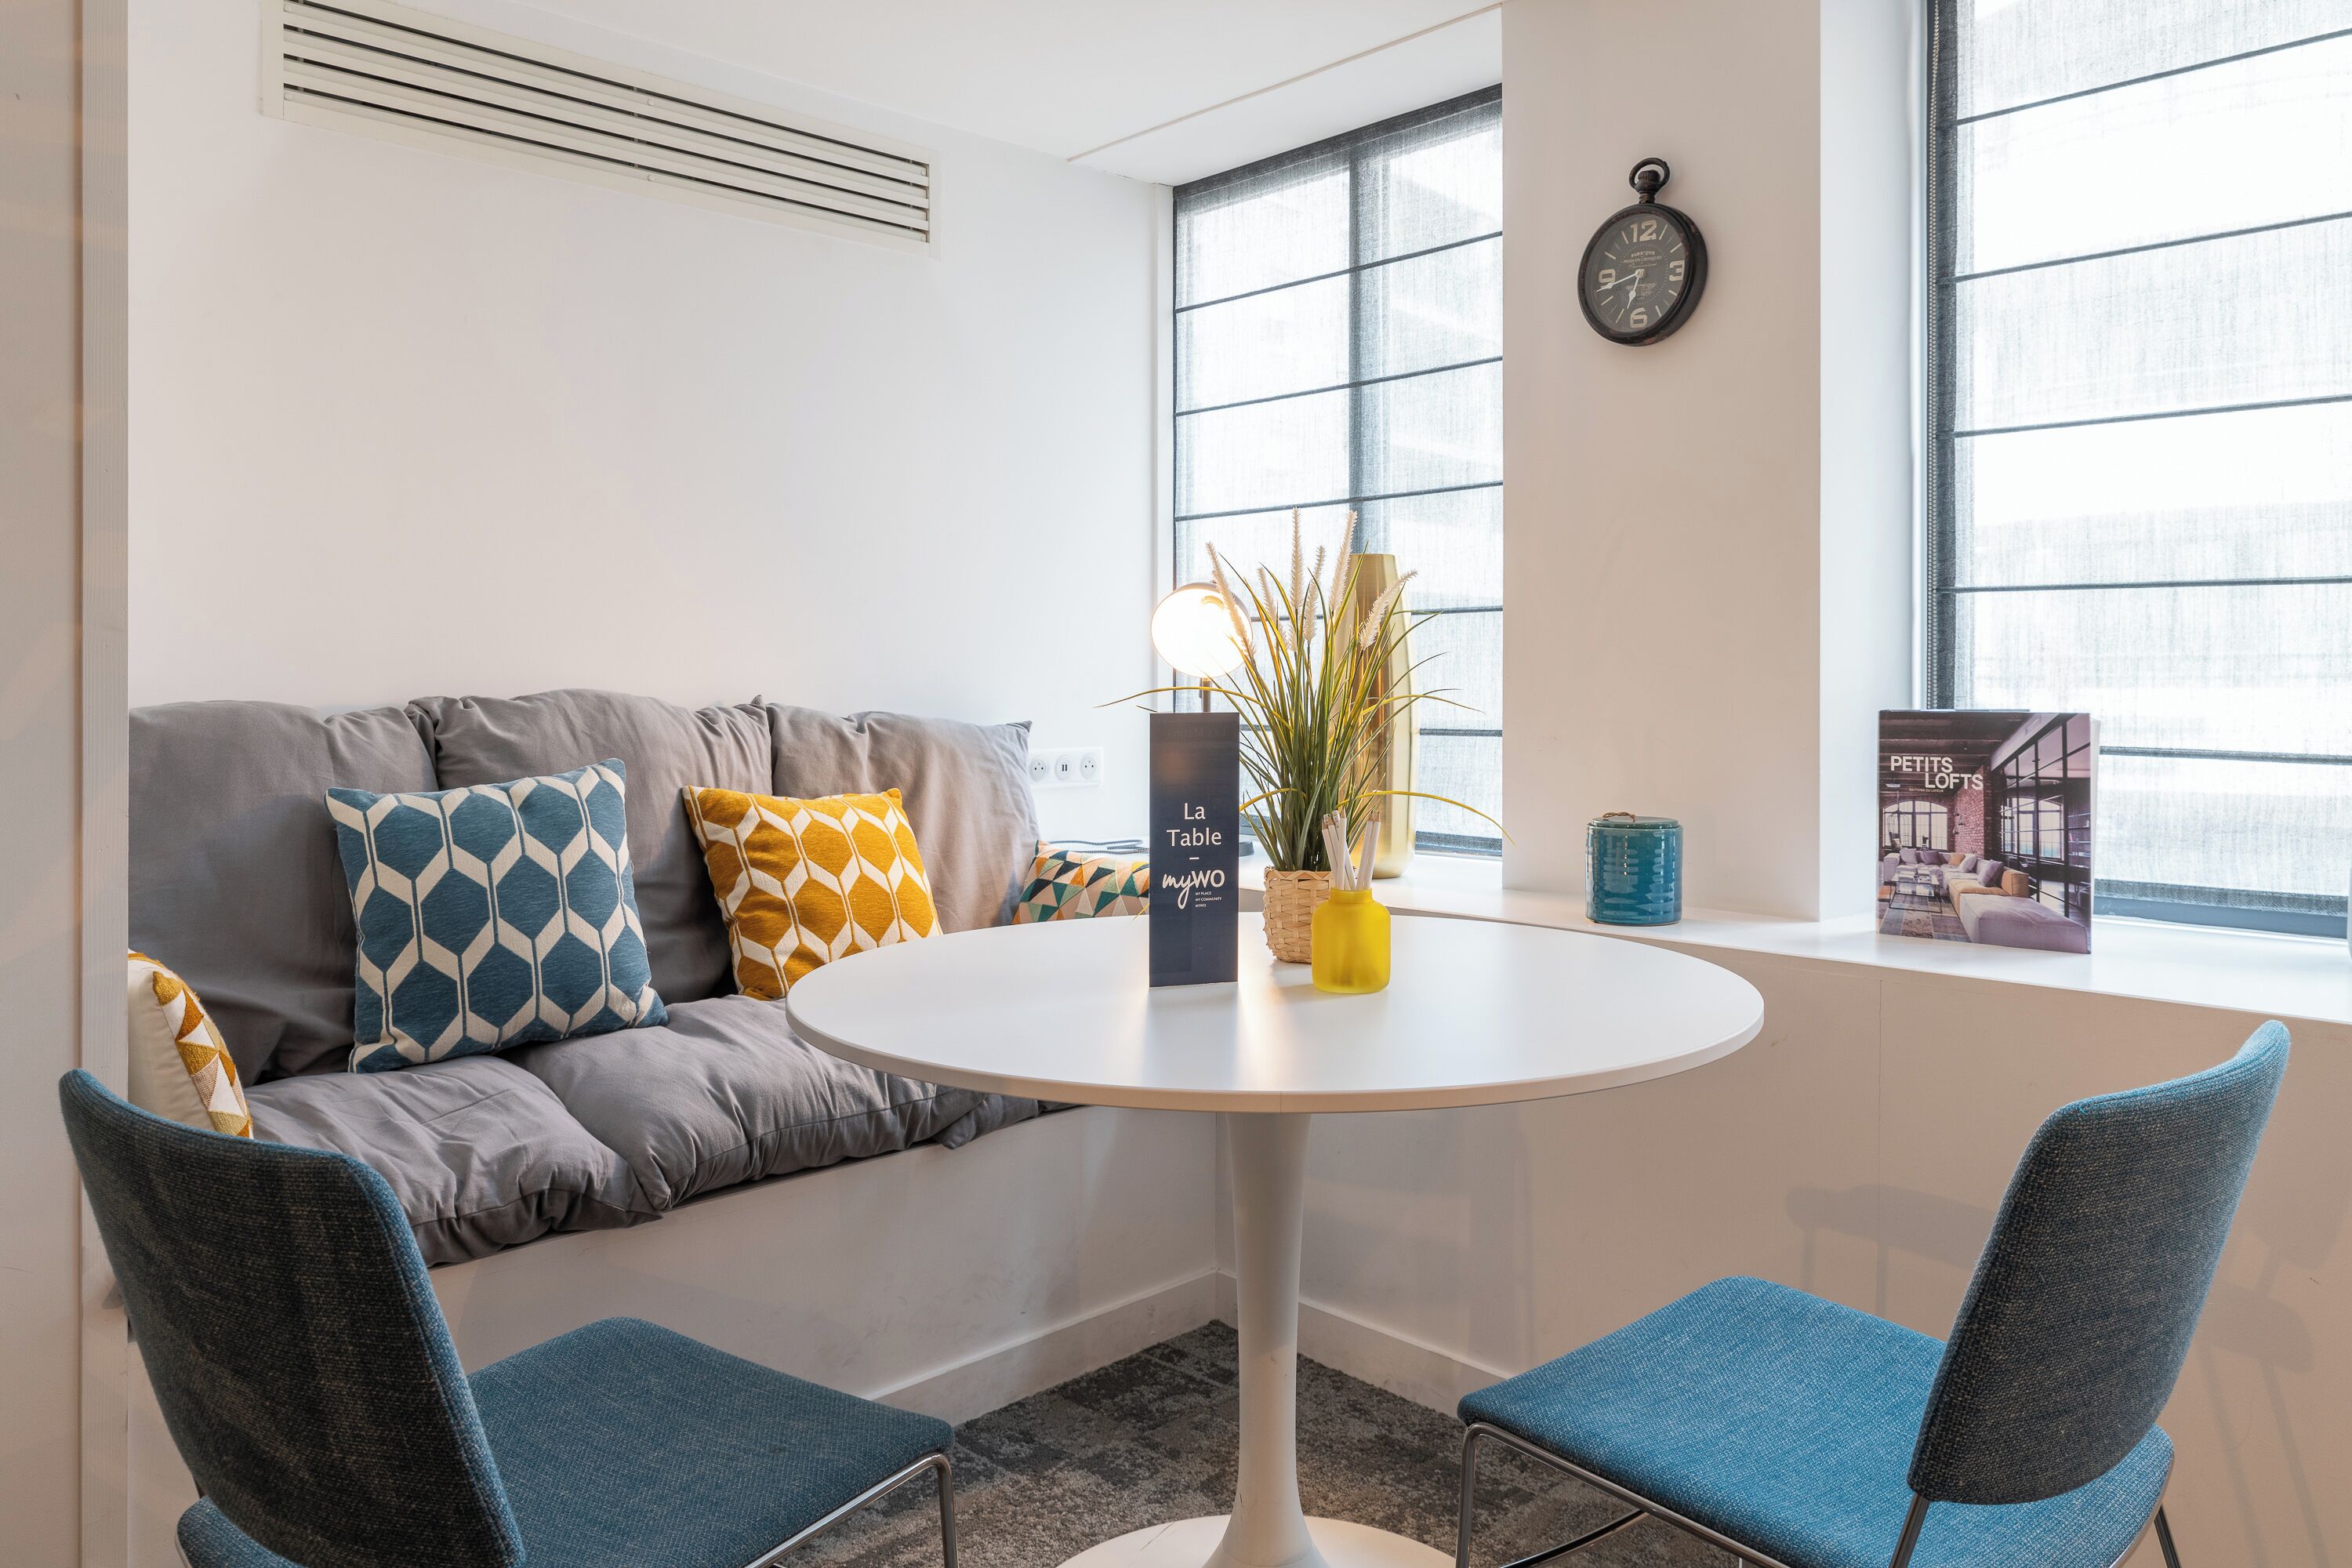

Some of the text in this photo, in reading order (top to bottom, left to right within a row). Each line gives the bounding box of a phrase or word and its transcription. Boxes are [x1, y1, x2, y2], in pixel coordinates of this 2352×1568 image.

[1630, 220, 1657, 243] 12
[1599, 269, 1616, 289] 9
[1668, 260, 1684, 281] 3
[1629, 307, 1648, 329] 6
[1890, 756, 1953, 773] PETITS
[1925, 772, 1984, 790] LOFTS
[1184, 802, 1206, 820] La
[1166, 827, 1221, 847] Table
[1162, 869, 1225, 909] myWO
